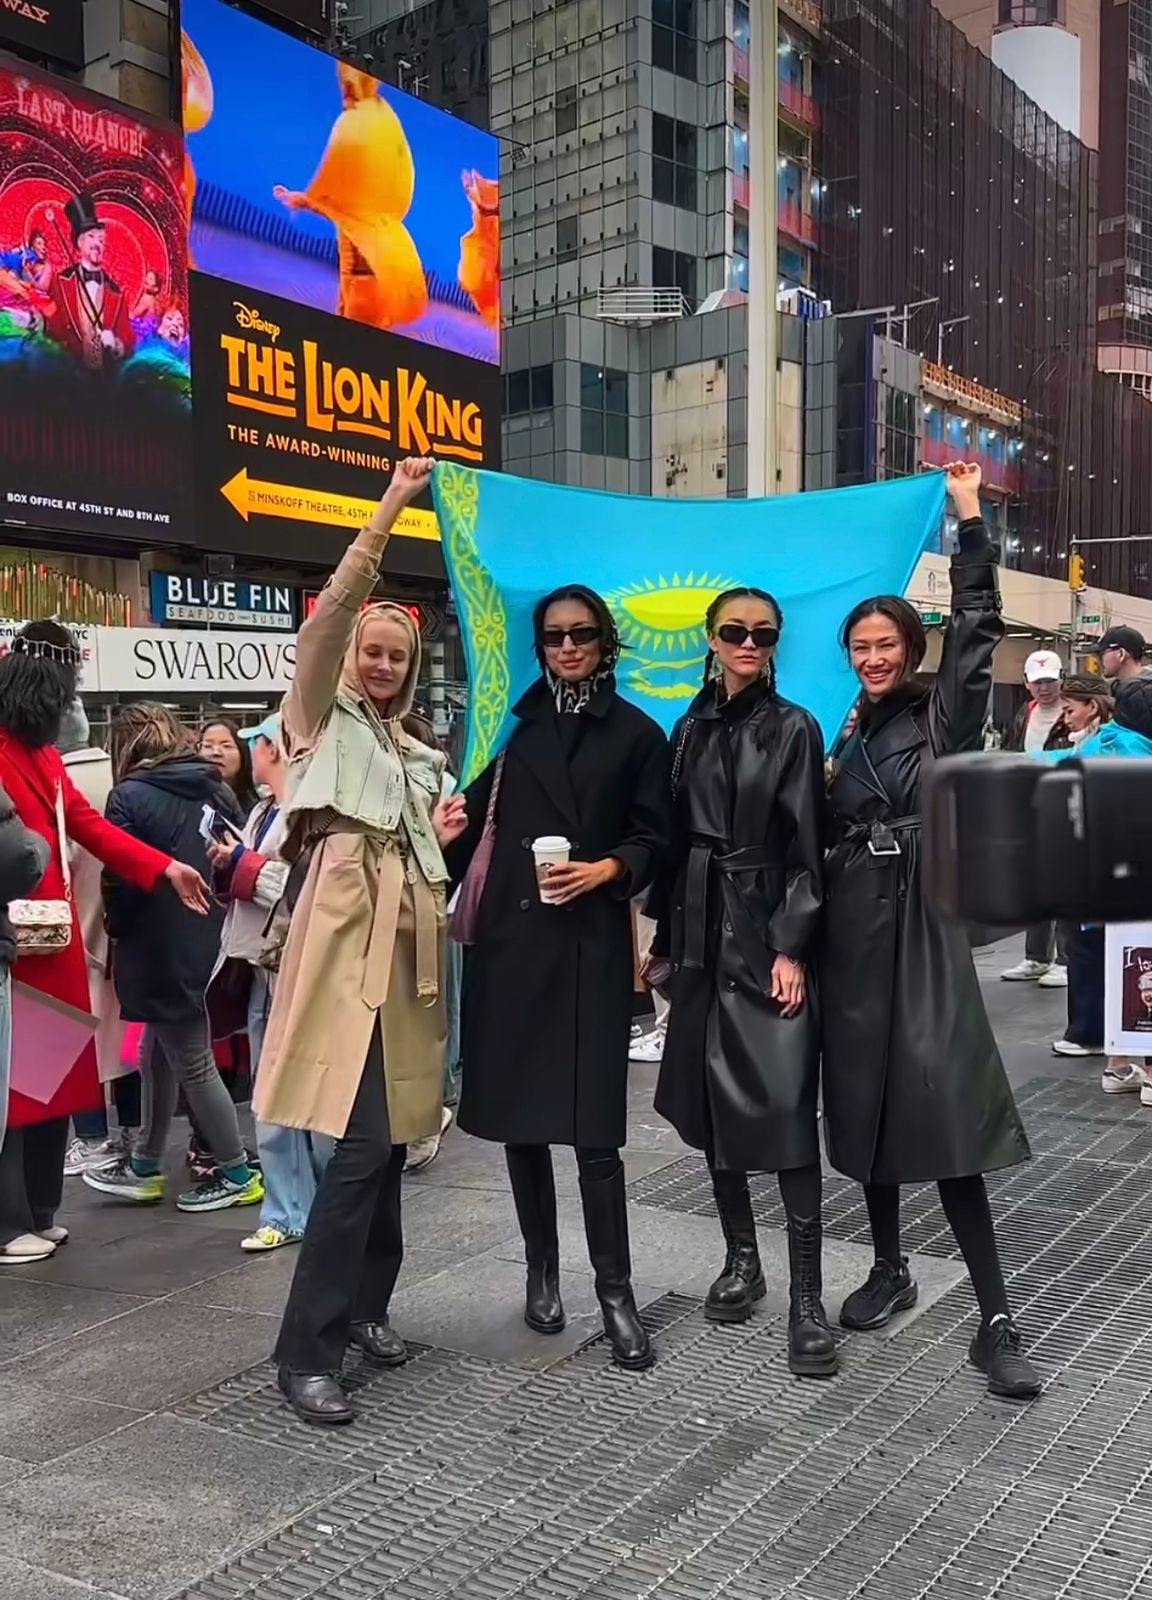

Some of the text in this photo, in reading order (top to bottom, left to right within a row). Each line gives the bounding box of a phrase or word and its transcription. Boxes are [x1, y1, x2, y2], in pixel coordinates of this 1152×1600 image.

[17, 86, 144, 158] LAST CHANCE!
[220, 334, 483, 456] THE LION KING
[227, 424, 390, 472] THE AWARD-WINNING
[7, 492, 171, 524] BOX OFFICE AT 45TH ST AND 8TH AVE
[257, 492, 304, 509] MINSKOFF
[305, 500, 346, 517] THEATRE,
[347, 508, 368, 520] 45TH
[167, 575, 291, 612] BLUE FIN
[168, 606, 235, 623] SEAFOOD
[252, 613, 291, 626] SUSHI
[134, 639, 296, 681] SWAROVS
